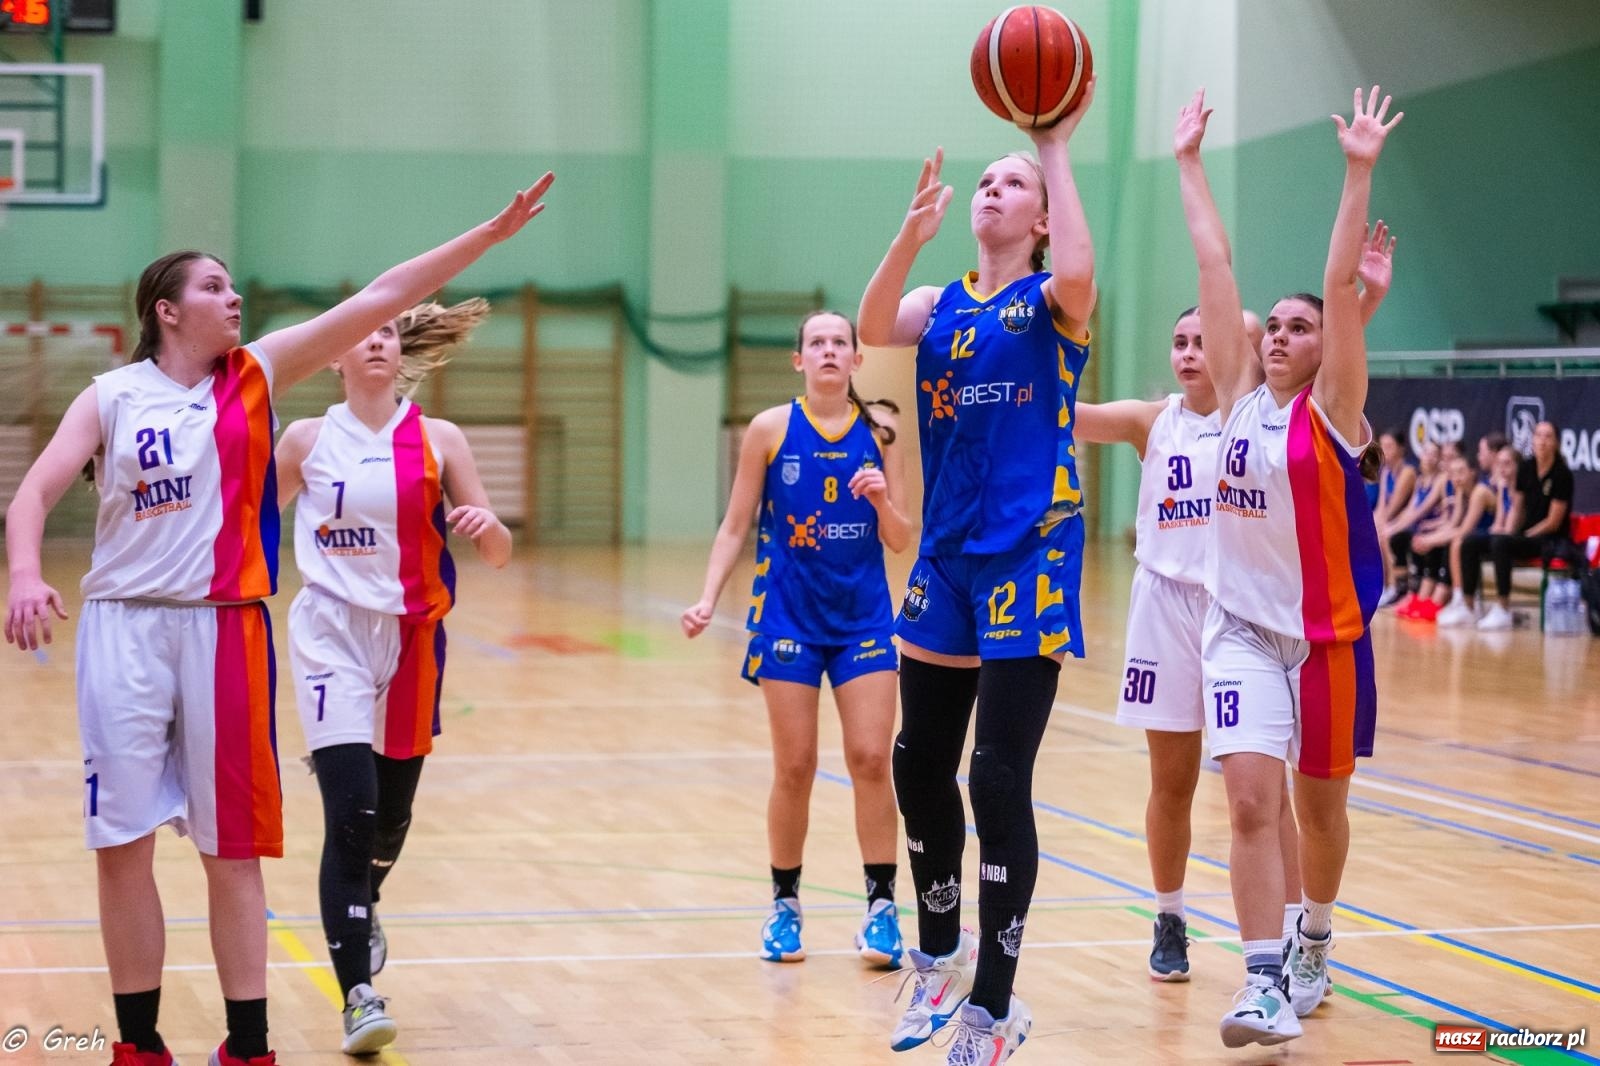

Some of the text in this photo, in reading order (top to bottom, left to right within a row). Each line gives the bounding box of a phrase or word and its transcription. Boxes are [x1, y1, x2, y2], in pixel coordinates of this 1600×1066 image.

[951, 326, 976, 360] 12
[136, 427, 174, 471] 21
[1225, 437, 1249, 477] 13
[823, 476, 838, 503] 8
[1167, 455, 1192, 491] 30
[131, 475, 192, 511] MINI
[332, 481, 345, 519] 7
[1158, 498, 1211, 521] MINI
[1216, 485, 1267, 509] MINI
[314, 527, 376, 548] MINI
[988, 581, 1016, 625] 12
[983, 629, 1022, 640] regio
[313, 684, 326, 722] 7
[1124, 667, 1156, 704] 30
[1214, 690, 1239, 728] 13
[908, 837, 924, 853] NBA
[986, 864, 1007, 883] NBA
